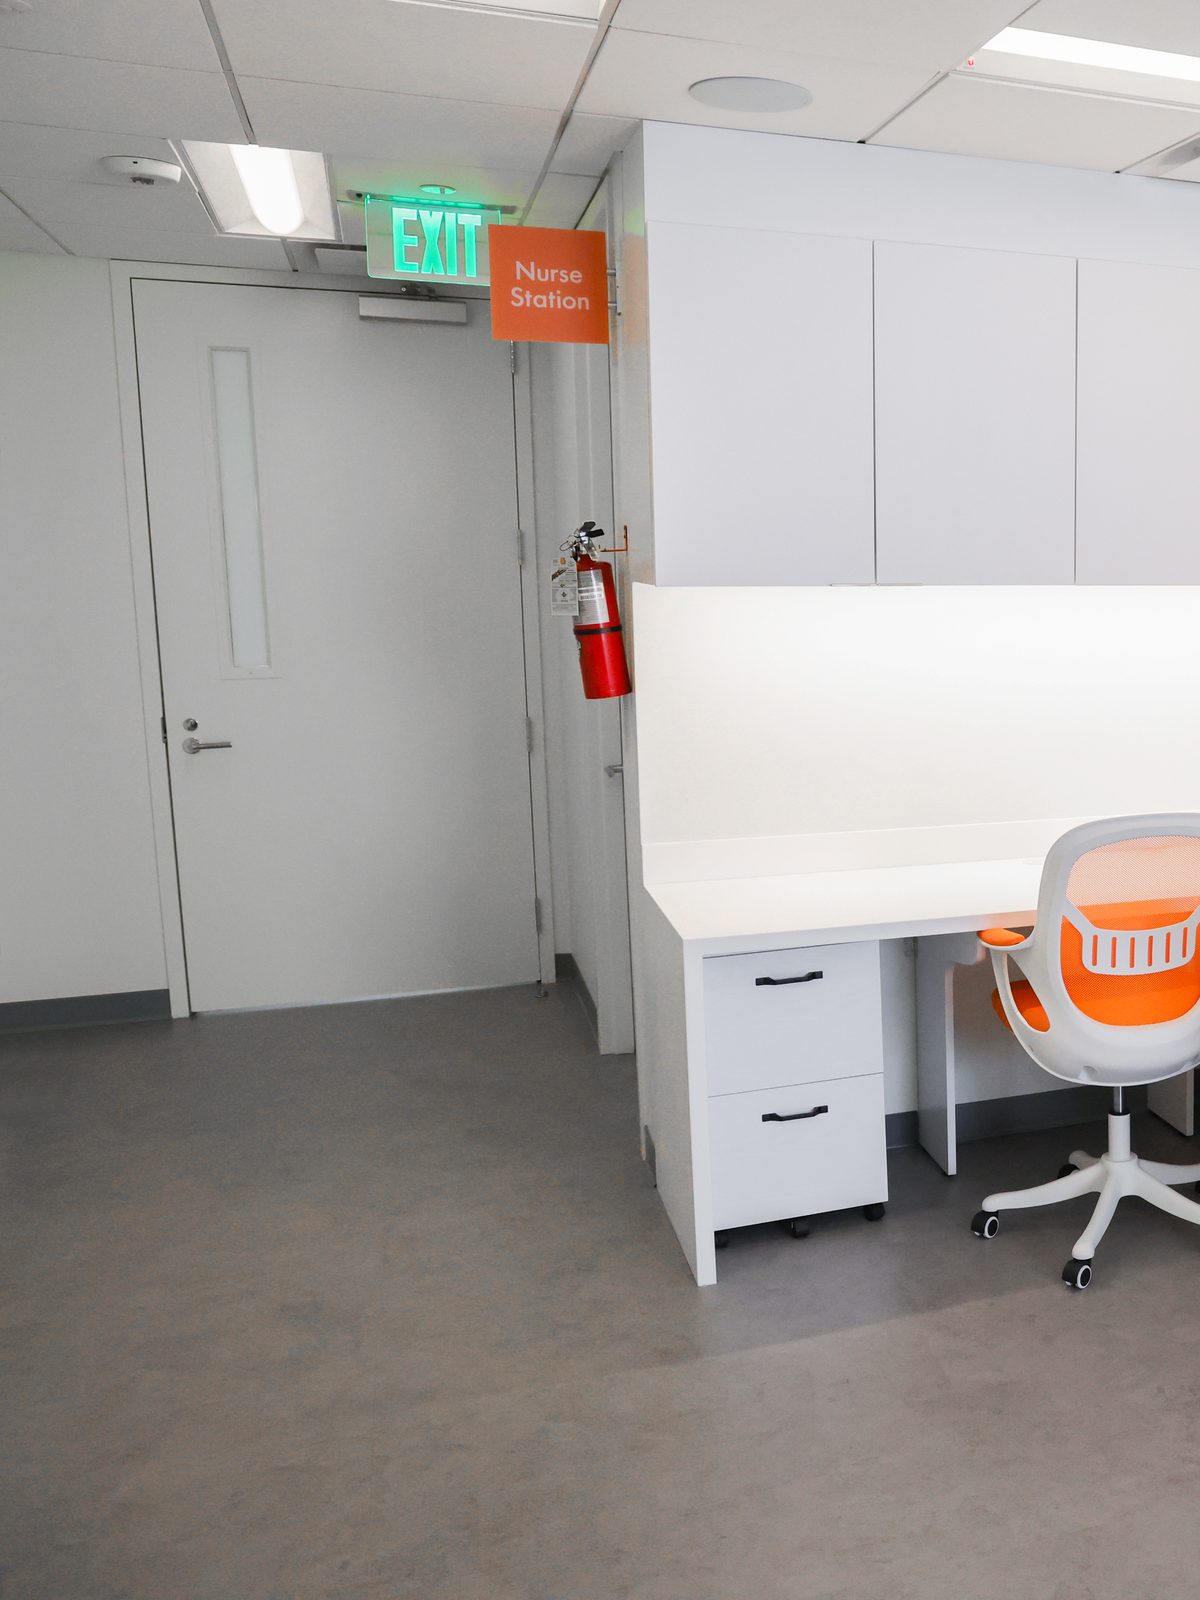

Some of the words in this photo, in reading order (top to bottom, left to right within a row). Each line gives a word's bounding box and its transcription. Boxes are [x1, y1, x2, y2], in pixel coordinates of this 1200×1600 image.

[392, 207, 482, 278] EXIT
[515, 260, 583, 283] Nurse
[510, 287, 590, 310] Station
